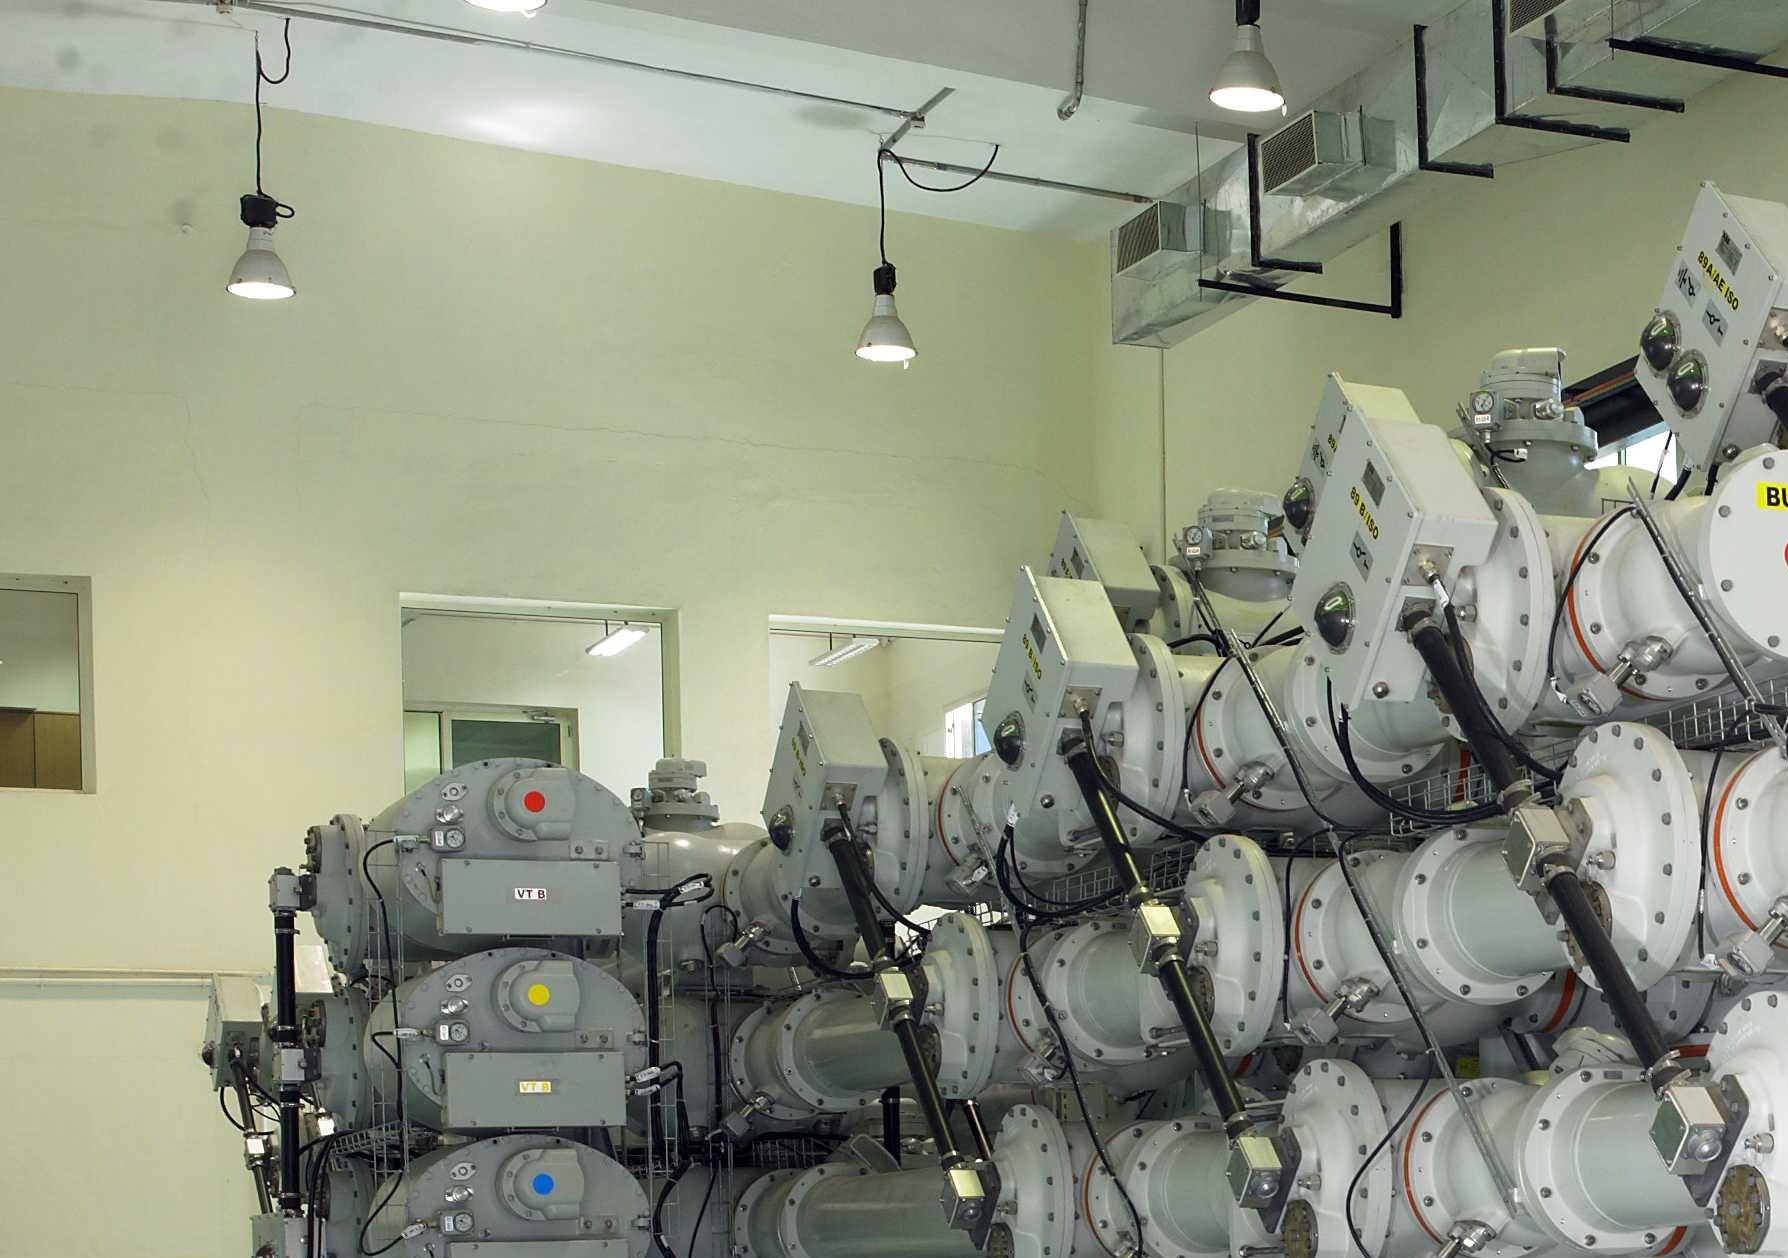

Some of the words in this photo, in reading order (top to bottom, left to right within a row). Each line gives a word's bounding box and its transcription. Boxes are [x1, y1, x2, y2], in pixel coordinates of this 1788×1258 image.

[1723, 286, 1739, 311] ISO
[1350, 486, 1361, 507] 89
[1359, 503, 1379, 540] B/ISO
[517, 889, 533, 898] VT
[538, 890, 545, 899] B
[521, 1082, 537, 1091] VT
